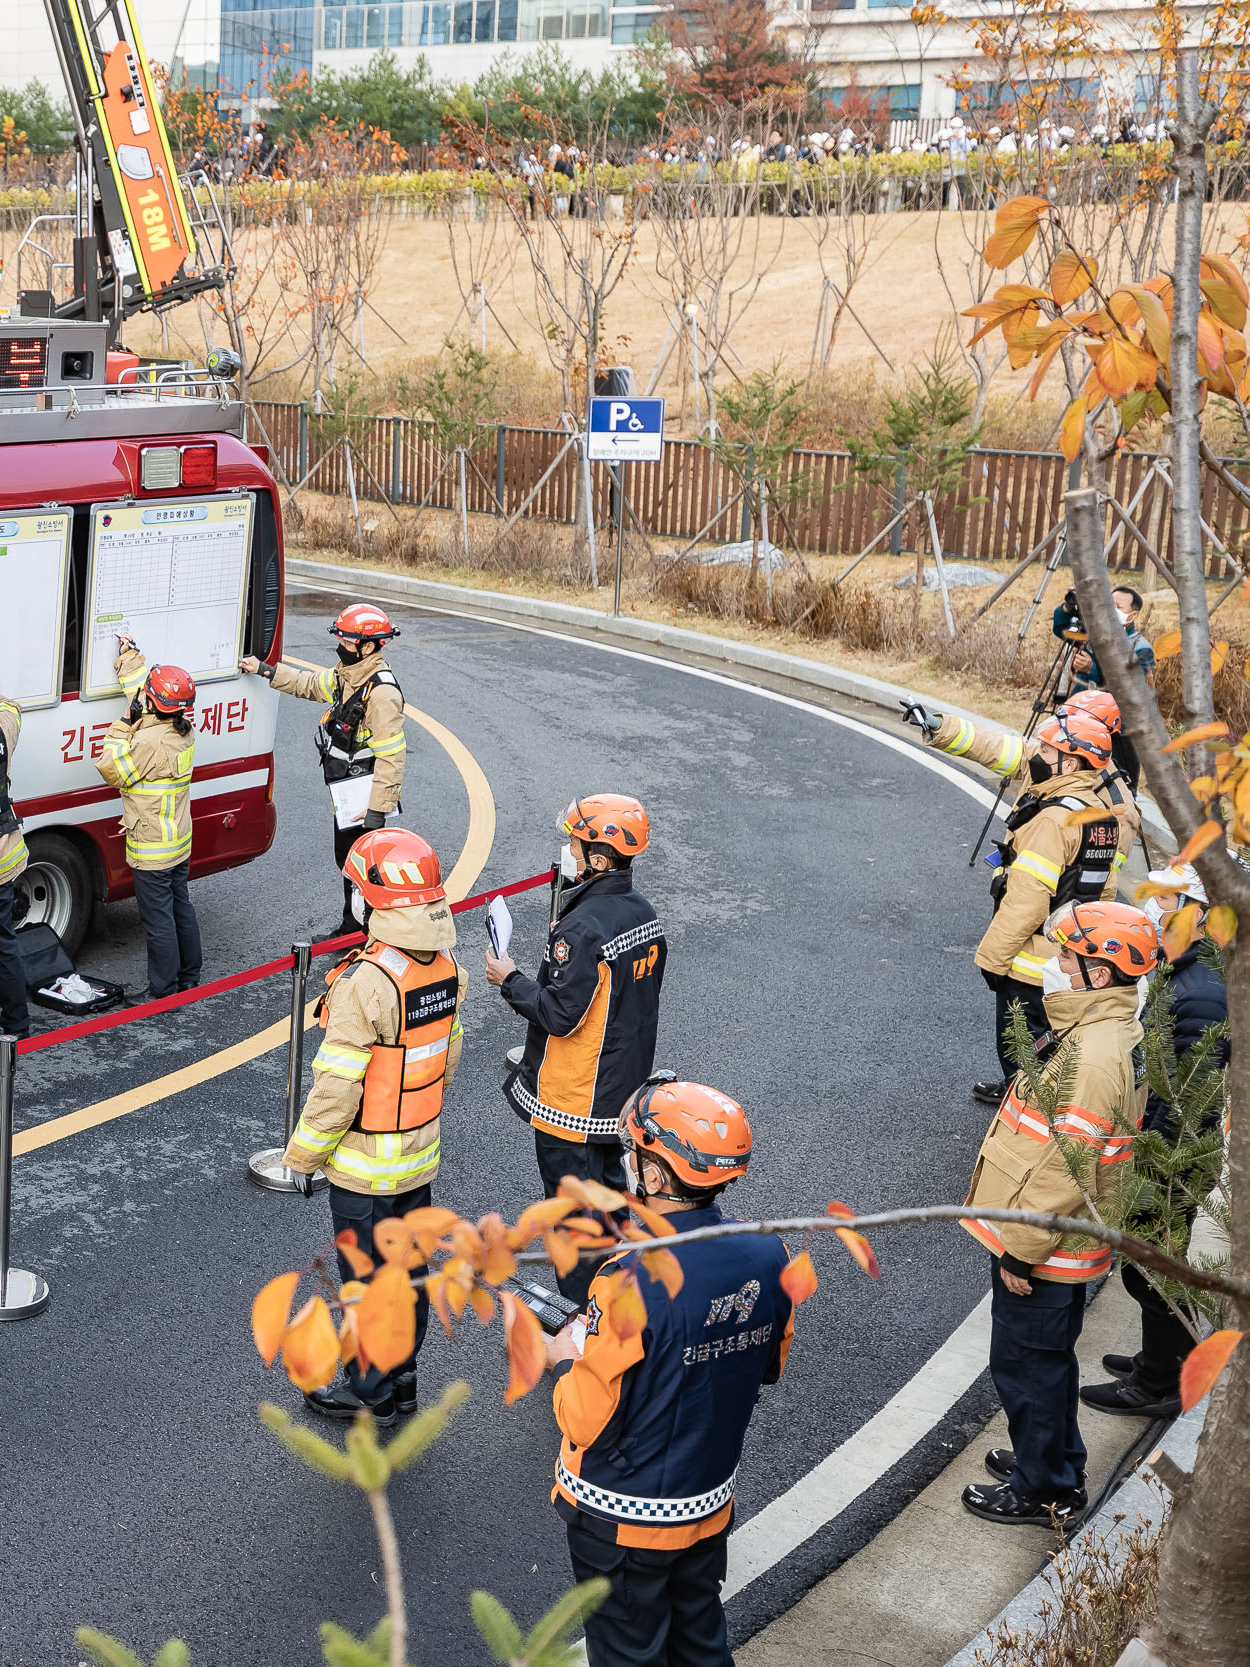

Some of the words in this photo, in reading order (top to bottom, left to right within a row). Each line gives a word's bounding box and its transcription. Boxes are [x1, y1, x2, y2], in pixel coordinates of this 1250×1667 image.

[138, 188, 172, 252] 18M
[609, 402, 631, 431] P
[37, 520, 64, 530] 광진소방서
[156, 509, 195, 521] 인명피해상황
[1088, 826, 1119, 847] 서울소방
[632, 944, 659, 982] 119
[419, 989, 448, 1006] 광진소방서
[644, 1118, 661, 1136] PETZL
[715, 1157, 738, 1168] PETZL
[703, 1279, 762, 1327] 119
[682, 1322, 774, 1366] 긴급구조통제단
